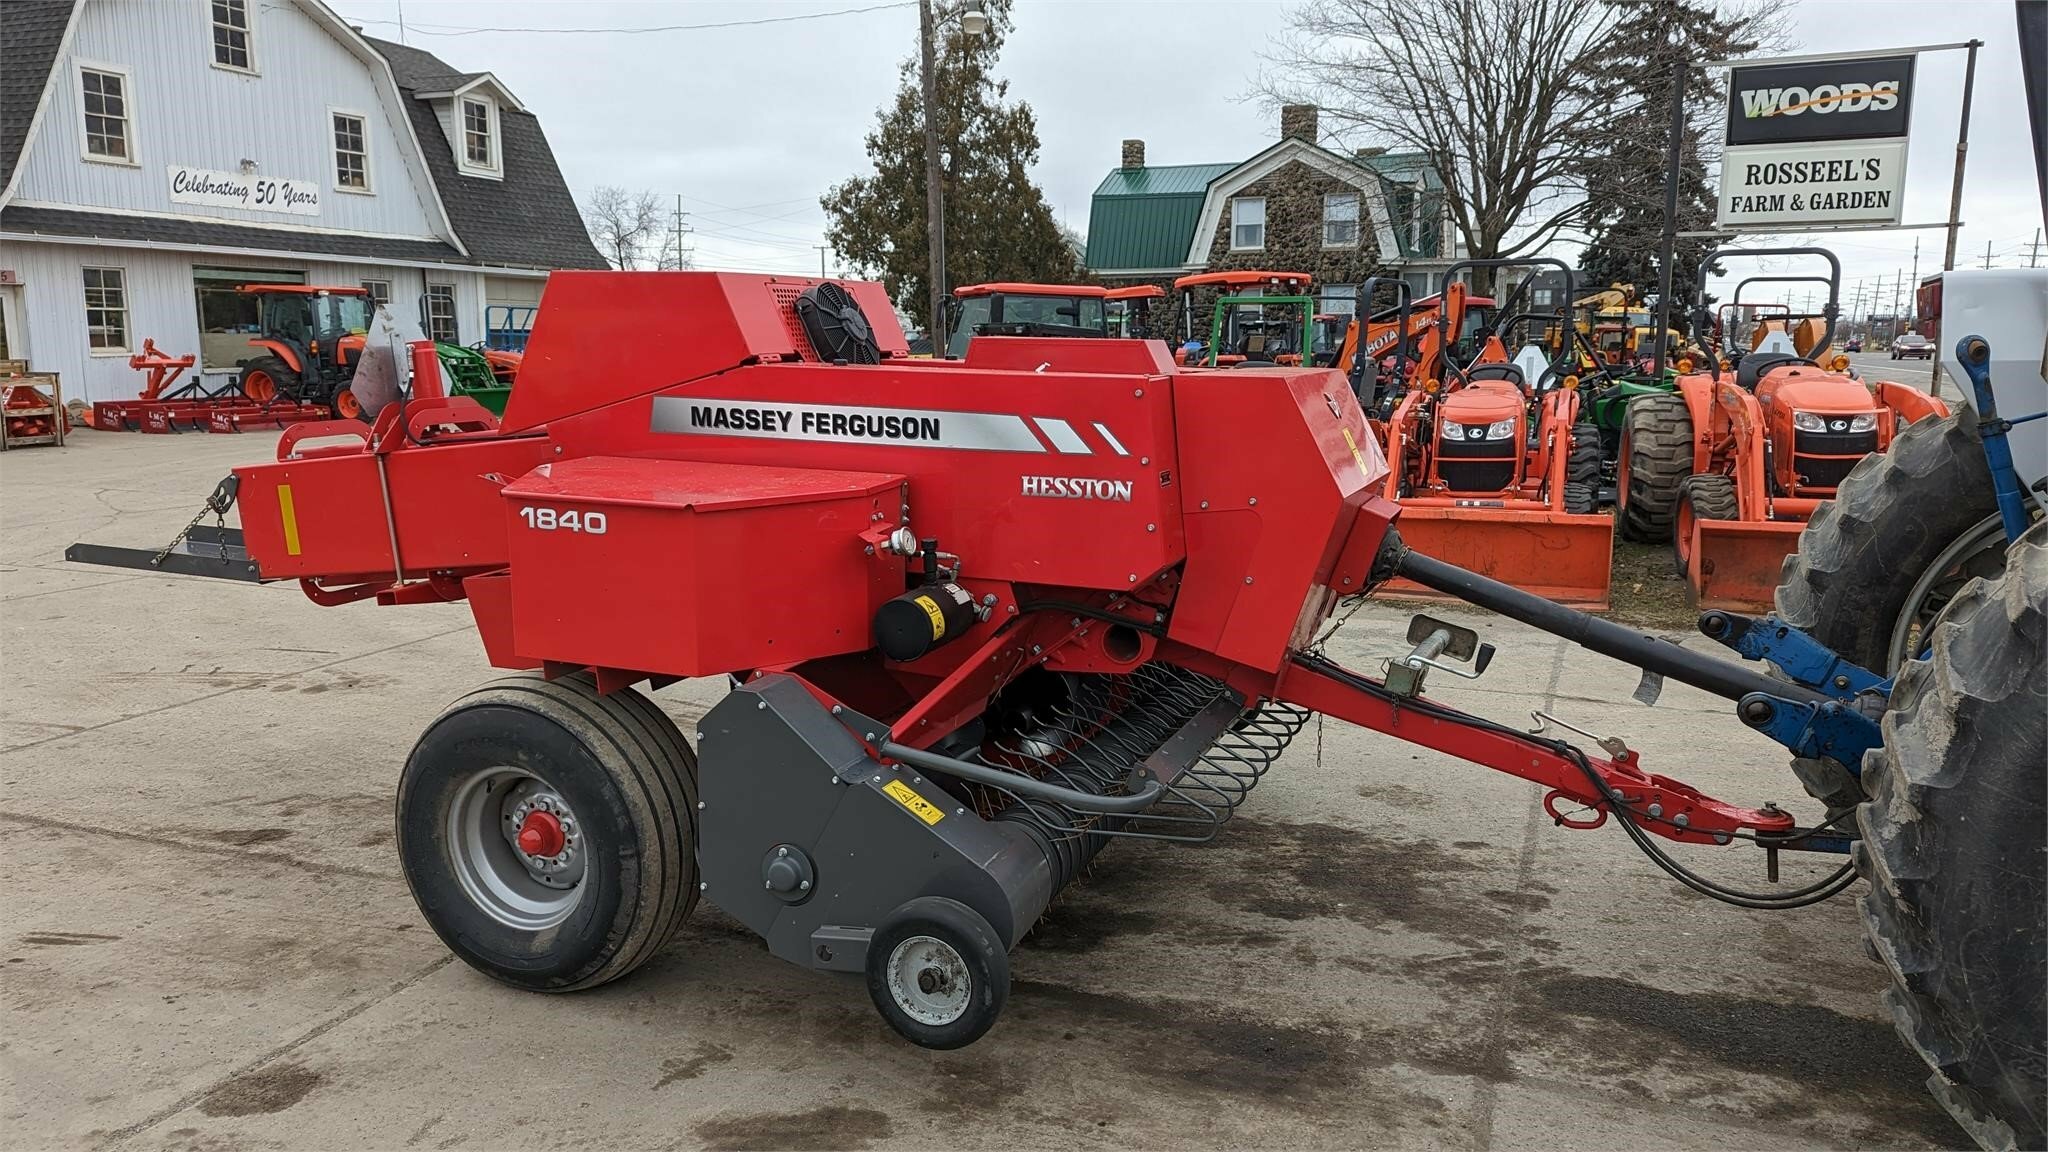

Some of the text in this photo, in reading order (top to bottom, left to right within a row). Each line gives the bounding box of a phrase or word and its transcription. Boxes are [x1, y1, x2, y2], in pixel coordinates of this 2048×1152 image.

[1740, 81, 1899, 119] WOODS
[1745, 158, 1881, 186] ROSSEEL'S
[173, 170, 318, 207] Celebrating 50 Years
[1730, 191, 1891, 213] FARM & GARDEN
[691, 406, 941, 441] MASSEY FERGUSON
[1021, 476, 1133, 502] HESSTON
[520, 506, 607, 534] 1840
